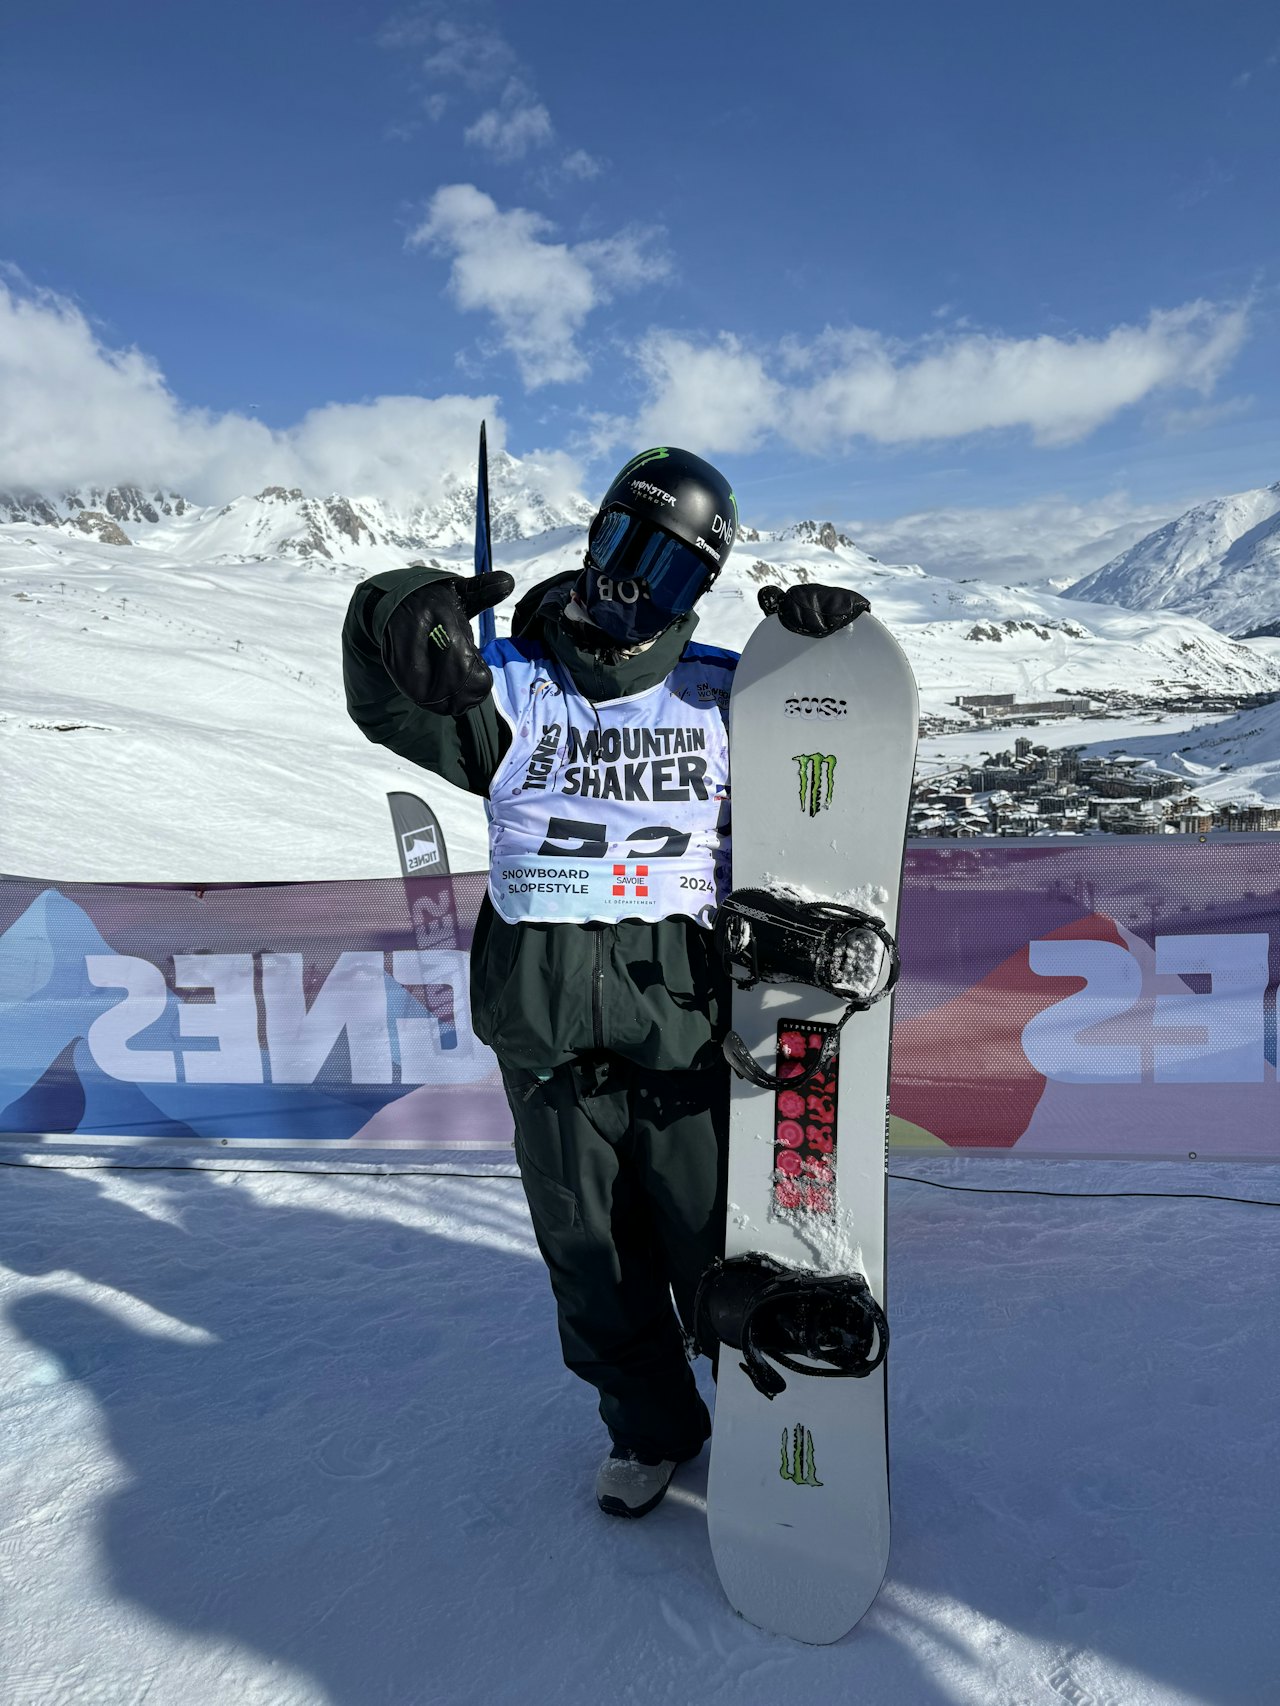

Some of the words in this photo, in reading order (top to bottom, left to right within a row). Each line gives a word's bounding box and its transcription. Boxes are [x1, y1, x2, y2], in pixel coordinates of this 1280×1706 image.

[522, 723, 562, 790] TIGNES
[561, 756, 709, 802] SHAKER
[502, 868, 590, 880] SNOWBOARD
[616, 876, 645, 885] SAVOIE
[508, 883, 589, 895] SLOPESTYLE
[679, 876, 714, 894] 2024
